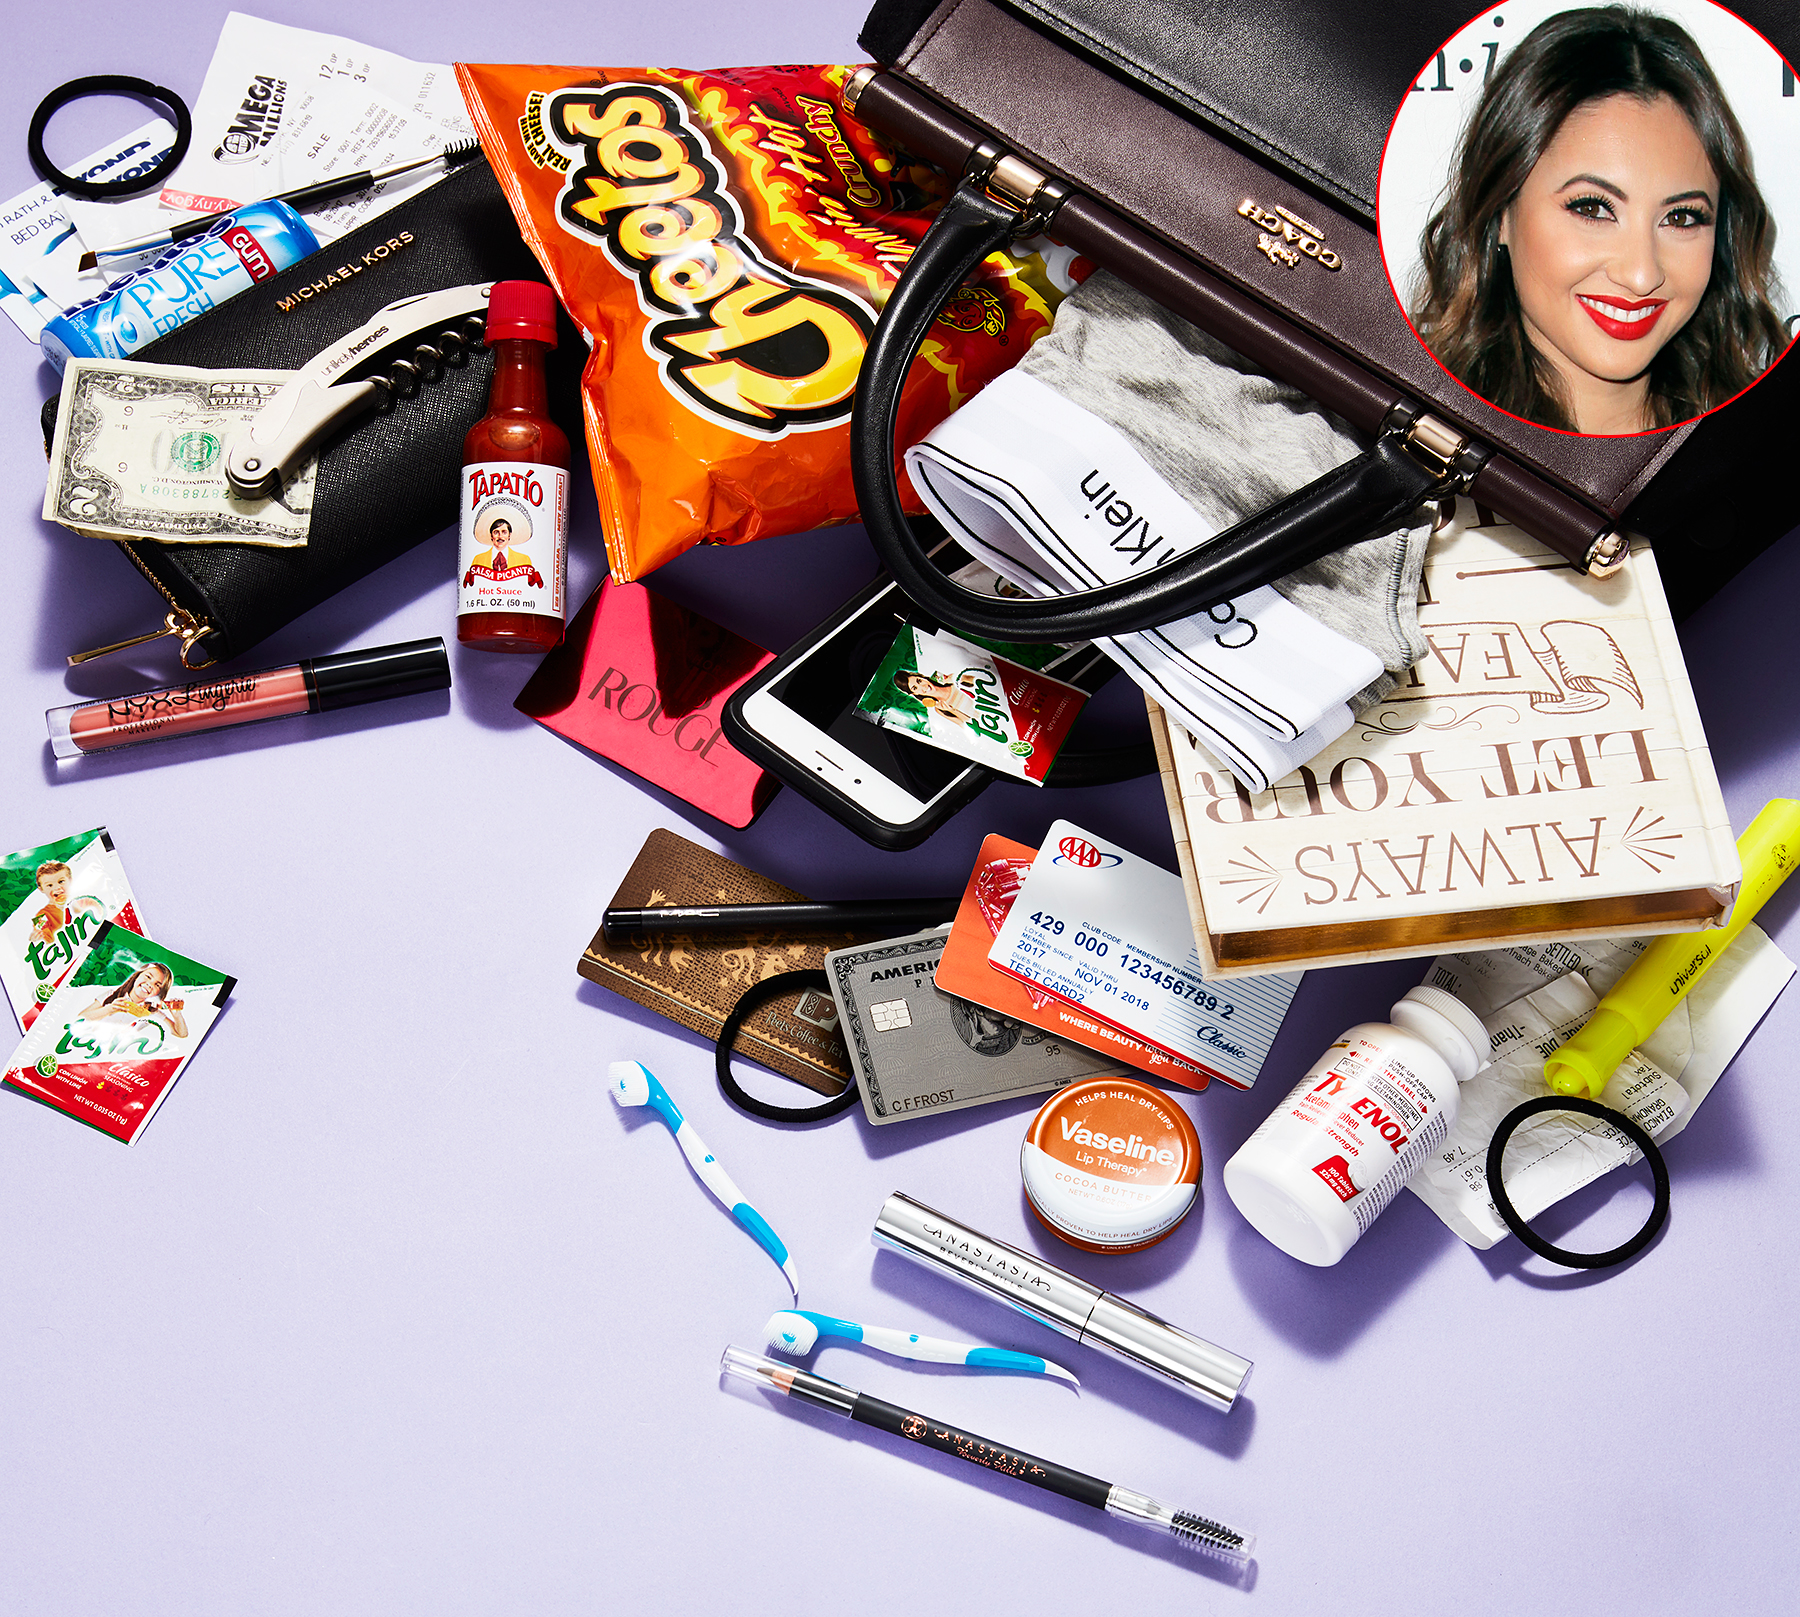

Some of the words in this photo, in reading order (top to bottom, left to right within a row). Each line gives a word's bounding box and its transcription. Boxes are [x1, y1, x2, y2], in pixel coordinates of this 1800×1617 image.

[227, 75, 276, 144] MEGA
[260, 80, 288, 147] MILLIONS
[528, 93, 546, 146] CHEESE!
[307, 133, 331, 159] SALE
[520, 118, 531, 144] WITH
[748, 103, 831, 183] Hot
[527, 142, 545, 167] MADE
[542, 143, 572, 171] REAL
[795, 95, 881, 207] Crunchy
[10, 224, 39, 246] BED
[1237, 200, 1341, 268] COACH
[275, 263, 363, 311] MICHAEL
[361, 231, 414, 266] KORS
[558, 90, 872, 422] Cheetos
[126, 240, 241, 319] PURE
[69, 485, 100, 516] 2
[1080, 469, 1164, 566] Klein
[470, 566, 494, 580] SALSA
[496, 567, 534, 580] PICANTE
[466, 600, 475, 608] 1.6
[476, 599, 488, 607] FL.
[489, 598, 504, 607] OZ.
[507, 598, 521, 608] (50
[522, 600, 536, 609] ml)
[478, 587, 494, 596] Hot
[496, 587, 522, 596] Sauce
[108, 692, 172, 719] NYX
[172, 676, 257, 712] Lingerie
[112, 716, 176, 733] PROFESSIONAL
[129, 725, 162, 736] MAKEUP
[587, 666, 728, 768] ROUGE
[1481, 727, 1668, 801] LET
[1061, 838, 1101, 867] AAA
[1294, 816, 1607, 907] ALWAYS
[1024, 926, 1046, 940] LOYAL
[1030, 911, 1065, 935] 429
[1082, 921, 1101, 934] CLUB
[1101, 931, 1122, 945] CODE
[1017, 939, 1046, 958] 2017
[1021, 932, 1052, 951] MEMBER
[1052, 947, 1074, 962] SINCE
[1074, 931, 1109, 957] 000
[1544, 942, 1582, 971] SETTLED
[1012, 951, 1031, 965] DUES
[1031, 961, 1057, 977] BILLED
[1057, 974, 1094, 995] ANNUALLY
[1079, 960, 1099, 974] VALID
[1100, 971, 1119, 984] THRU
[1126, 943, 1172, 969] MEMBERSHIP
[1172, 965, 1202, 985] NUMBER
[1539, 954, 1564, 974] Baked
[1008, 959, 1041, 980] TEST
[1042, 976, 1085, 1004] CARD2
[1074, 968, 1103, 987] NOV
[1104, 982, 1118, 996] 01
[1121, 992, 1150, 1012] 2018
[1120, 954, 1218, 1012] 123456789
[1221, 1004, 1235, 1021] 2
[1432, 966, 1462, 994] TOTAL:
[790, 1024, 819, 1046] Coffee
[1059, 1012, 1098, 1034] WHERE
[1099, 1028, 1143, 1052] BEAUTY
[1149, 1052, 1170, 1066] you
[1197, 1025, 1247, 1059] Classic
[1046, 1045, 1061, 1057] 95
[104, 1075, 134, 1093] SEASONING
[1388, 1063, 1417, 1089] PUSH-OFF
[1416, 1088, 1428, 1101] CAP
[1391, 1058, 1416, 1080] LINE-UP
[1415, 1078, 1437, 1103] ARROWS
[1633, 1062, 1653, 1076] Tax
[914, 1089, 955, 1108] FROST
[1383, 1069, 1396, 1082] THE
[1397, 1079, 1416, 1101] LABEL
[1621, 1071, 1662, 1100] Subtotal
[1075, 1091, 1107, 1107] HELPS
[1109, 1091, 1136, 1102] HEAL
[1138, 1097, 1157, 1112] DRY
[1156, 1111, 1175, 1131] LIPS
[1313, 1071, 1408, 1155] TYENOL
[1373, 1084, 1411, 1120] ACETAMINOPHEN
[1382, 1082, 1399, 1098] OTHER
[1398, 1094, 1420, 1122] MEDICINES
[1643, 1106, 1675, 1132] BIANCO
[1060, 1116, 1175, 1167] Vaseline
[1323, 1126, 1359, 1157] Strength
[1442, 1145, 1467, 1164] 7.49
[1076, 1150, 1094, 1165] Lip
[1097, 1155, 1147, 1178] Therapy
[1460, 1164, 1484, 1184] 0.61
[1055, 1172, 1098, 1190] COCOA
[1103, 1184, 1152, 1203] BUTTER
[1328, 1167, 1338, 1177] 100
[1337, 1175, 1353, 1194] Tablets
[1336, 1186, 1348, 1198] each
[1056, 1212, 1084, 1233] PROVEN
[1120, 1231, 1141, 1239] HEAL
[1142, 1225, 1157, 1235] DRY
[923, 1224, 1051, 1291] ANASTASIA
[934, 1429, 1046, 1477] ANASTASIA
[957, 1446, 991, 1468] Beverly
[994, 1460, 1018, 1476] Hills
